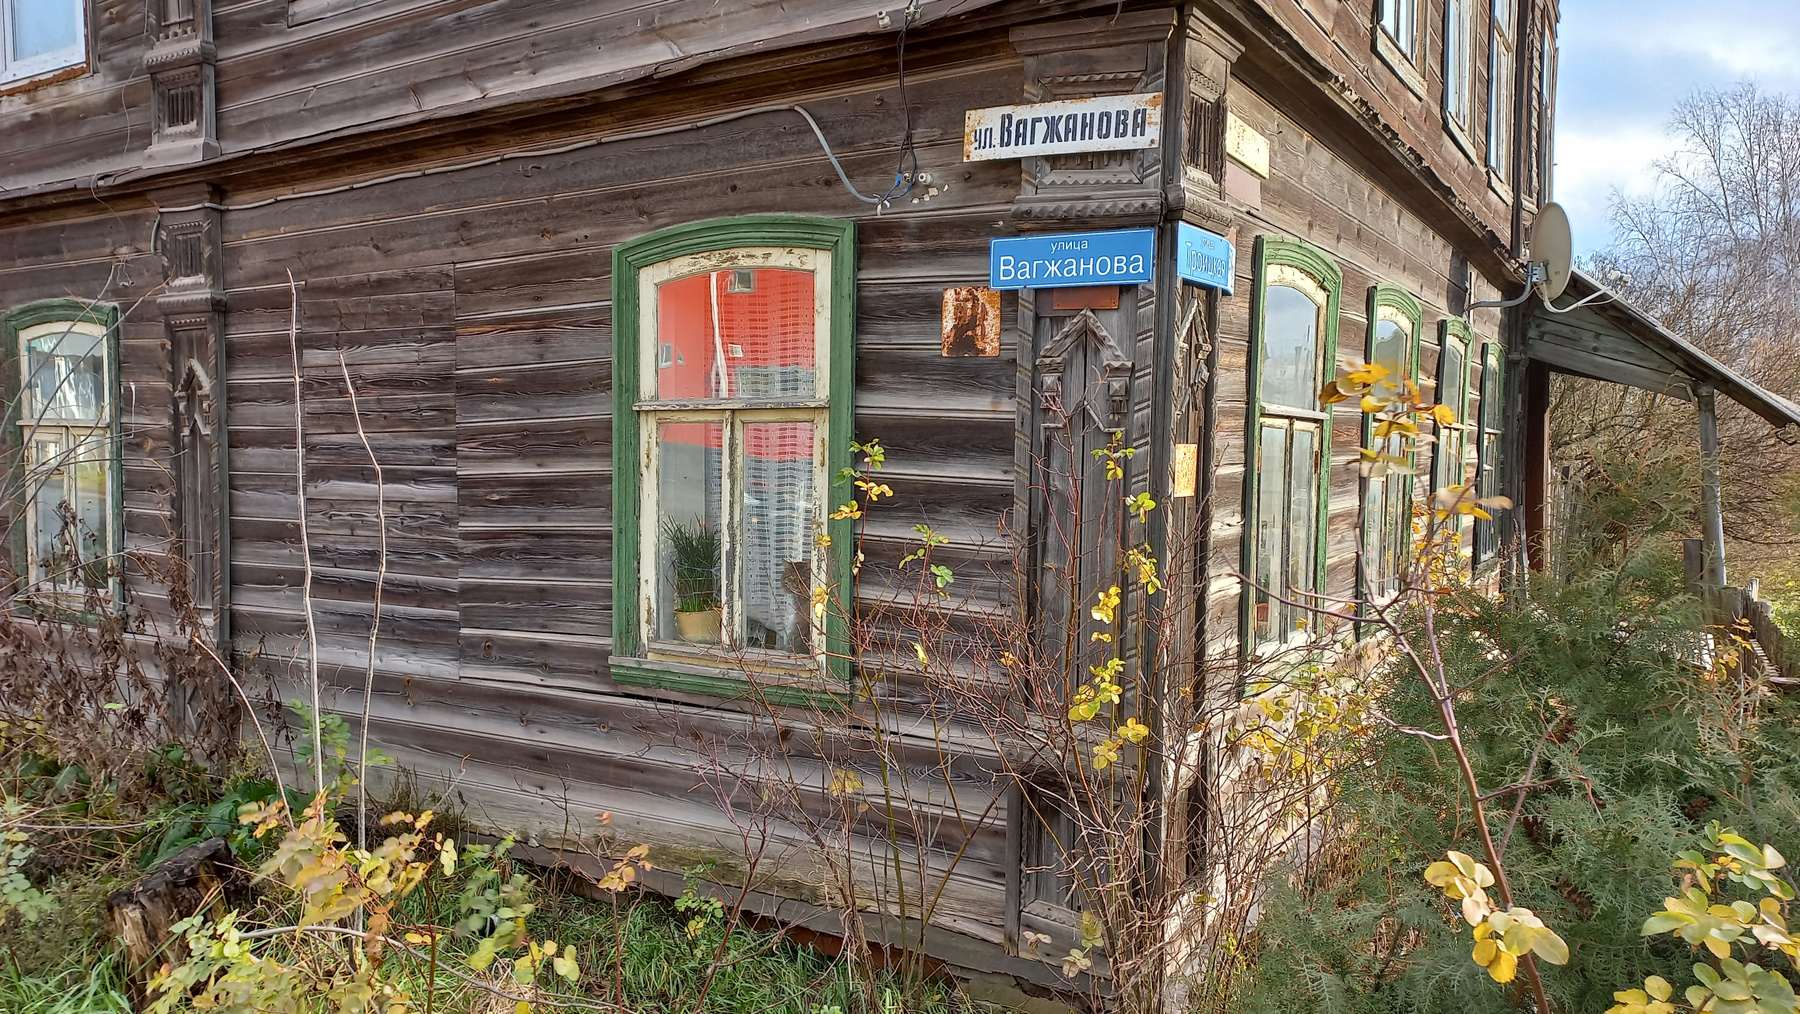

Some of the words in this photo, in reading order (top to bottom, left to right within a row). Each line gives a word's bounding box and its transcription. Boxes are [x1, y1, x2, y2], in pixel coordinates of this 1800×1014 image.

[1051, 240, 1089, 254] улица
[1185, 241, 1226, 280] Троицкая
[1000, 254, 1145, 281] Вагжанова
